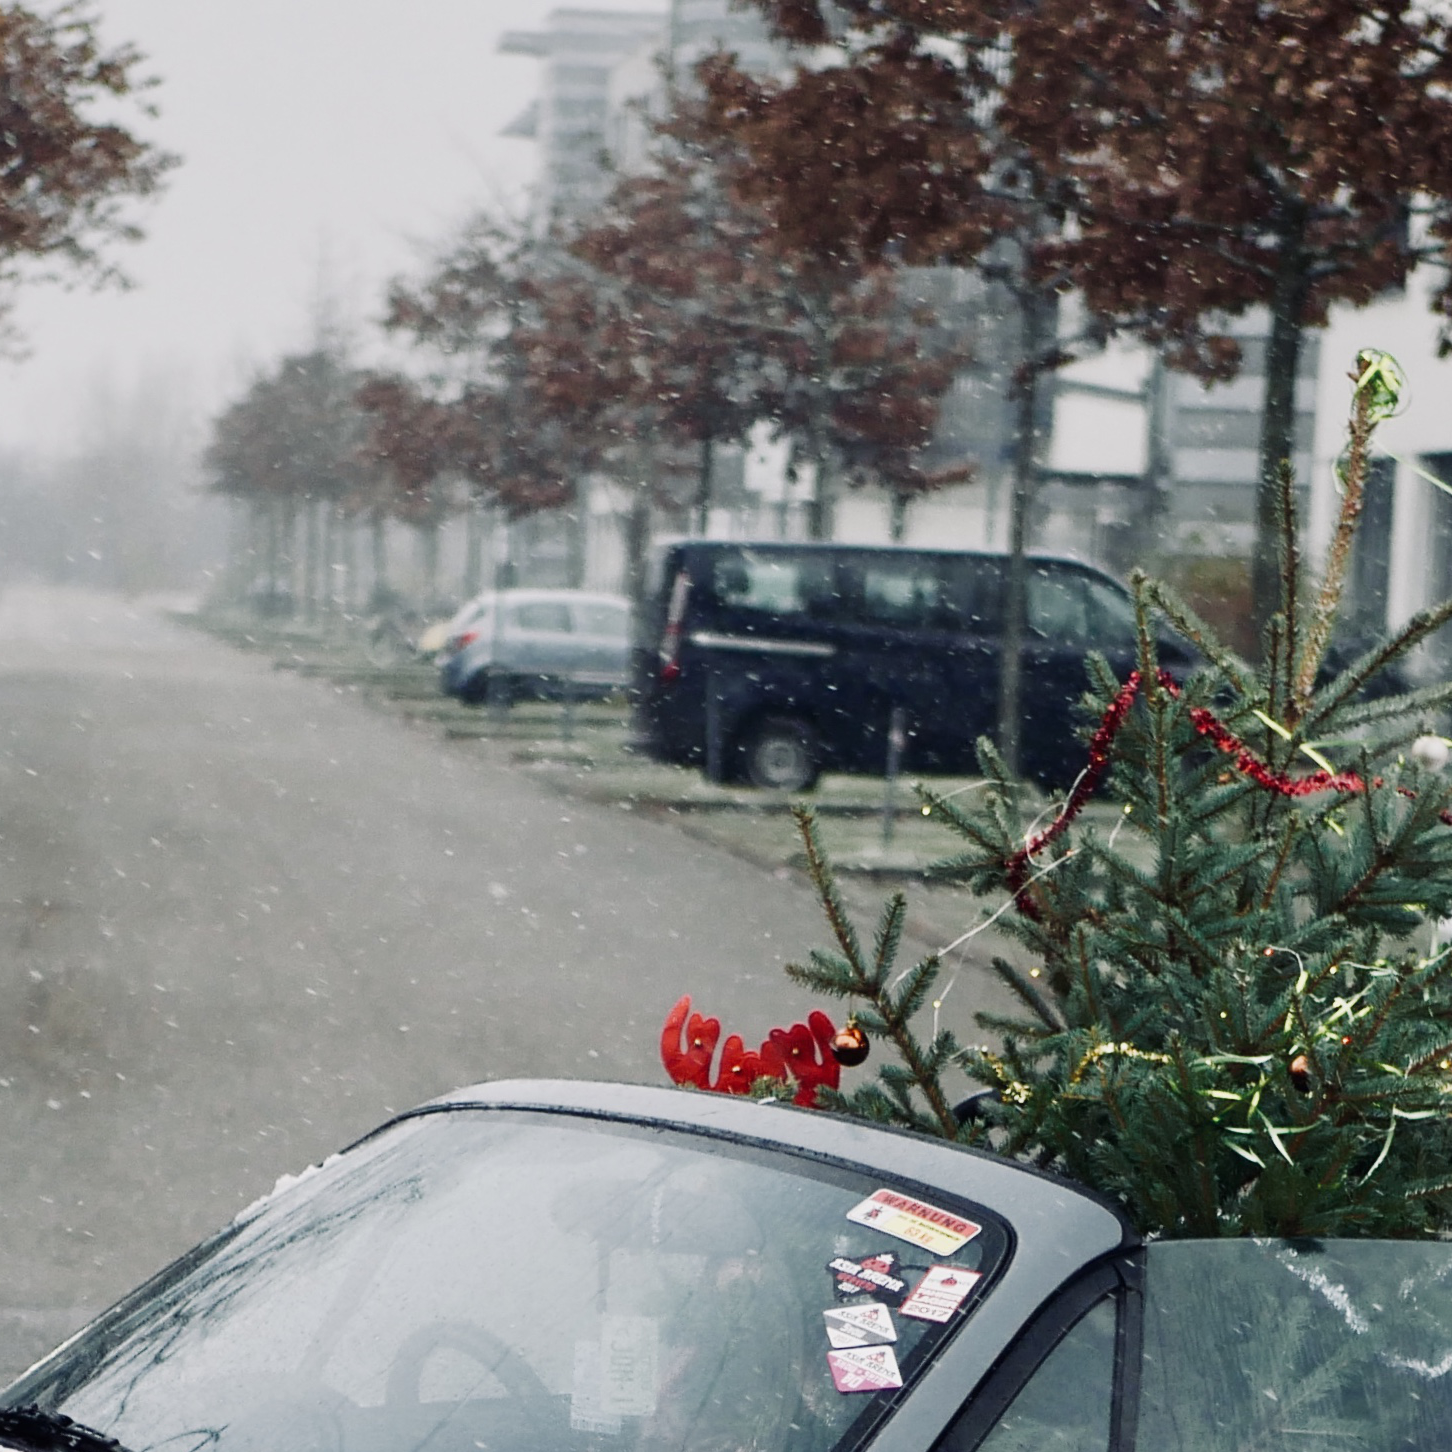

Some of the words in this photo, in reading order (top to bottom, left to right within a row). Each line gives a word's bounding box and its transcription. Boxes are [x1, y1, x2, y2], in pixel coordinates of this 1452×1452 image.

[883, 1194, 968, 1233] WARNUNG
[908, 1304, 949, 1317] 2017
[861, 1319, 890, 1333] ARENA
[866, 1360, 897, 1377] ARENA
